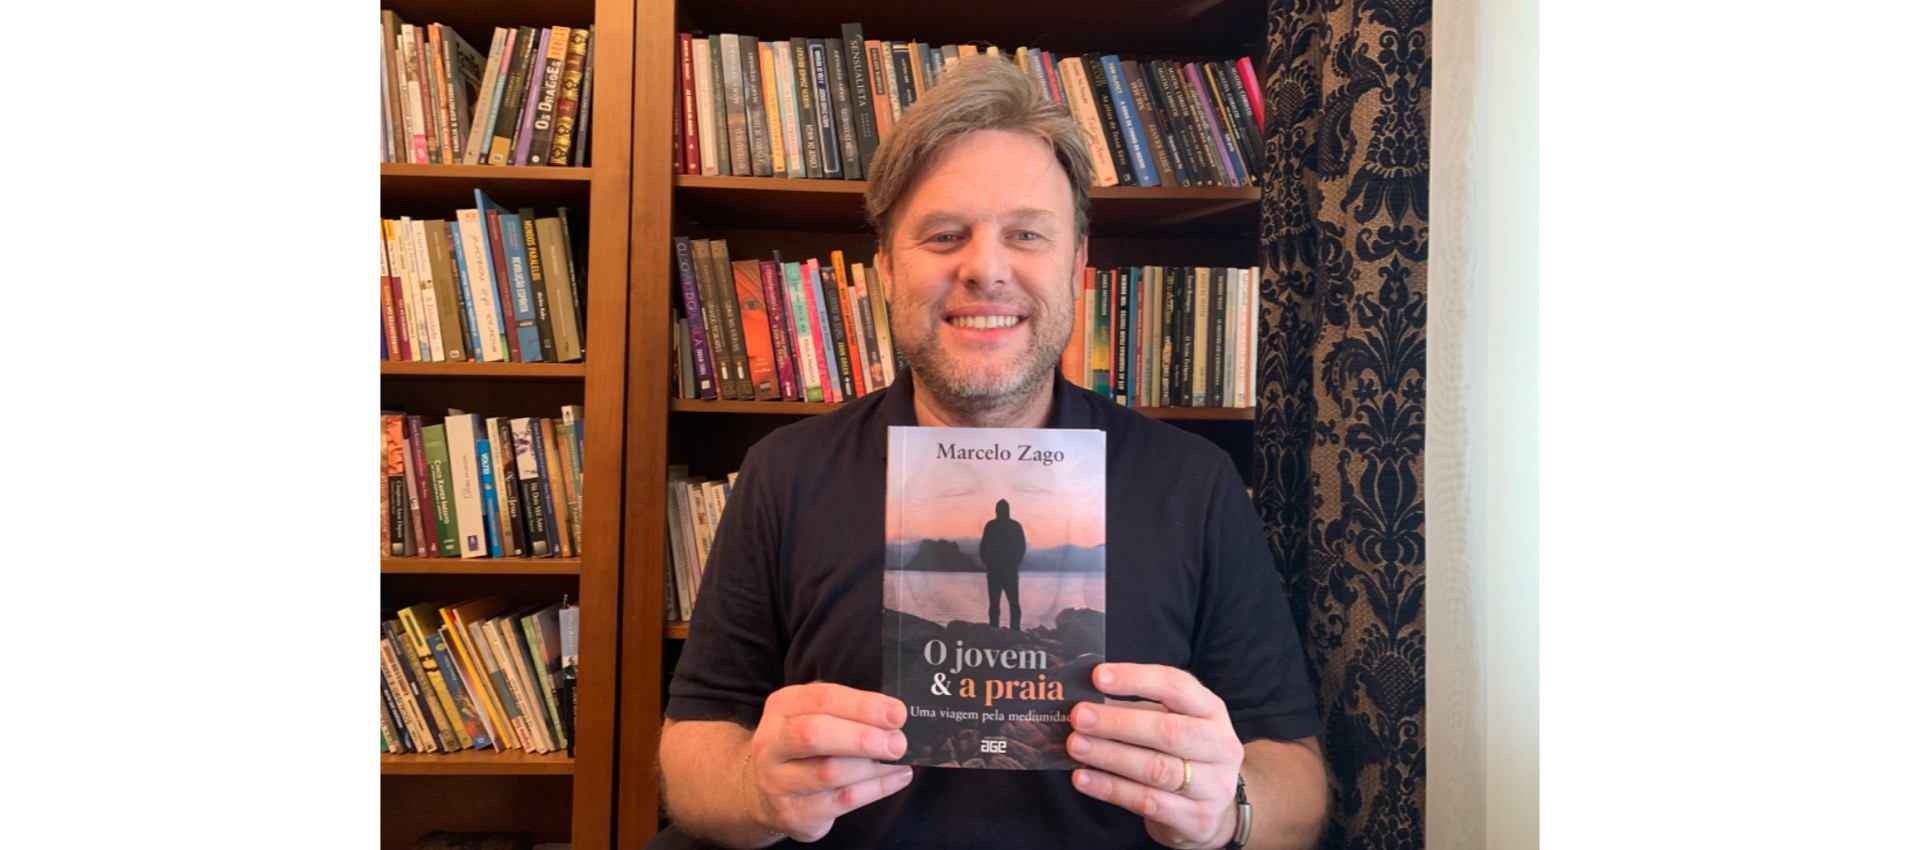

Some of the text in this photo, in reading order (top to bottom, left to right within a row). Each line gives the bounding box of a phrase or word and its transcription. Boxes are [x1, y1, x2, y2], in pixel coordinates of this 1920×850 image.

[729, 44, 738, 79] STEWART
[796, 47, 810, 108] MARION ZIMMER BRADLEY
[834, 50, 843, 80] STEWART
[850, 40, 866, 107] SENSUALISTA
[1108, 62, 1123, 94] TOM CLANCY
[447, 83, 458, 121] ESPIRITISMO
[751, 84, 759, 103] MARY
[1131, 82, 1145, 111] NAS ASAS
[1158, 67, 1169, 89] AGATHA
[1166, 91, 1179, 117] CHRISTIE
[1168, 67, 1189, 116] AGATHA CHRISTIE
[1219, 70, 1240, 118] AGATHA CHRISTIE
[1231, 67, 1252, 116] AGATHA CHRISTIE
[807, 141, 815, 149] DA
[1102, 95, 1109, 103] As
[1110, 121, 1117, 130] de
[1117, 150, 1126, 165] Kent
[1148, 124, 1163, 149] KRANTZ
[1135, 151, 1146, 169] MEDOS
[1158, 150, 1172, 173] JUDITH
[523, 220, 541, 281] MUNDOS PARALELOS
[384, 285, 392, 306] MENTE
[480, 288, 490, 306] de
[511, 256, 529, 313] REVOLUÇÃO ESPÍRITA
[389, 316, 398, 354] HORIZONTES
[486, 314, 498, 352] maria
[802, 338, 815, 383] PAULA PIMENTA
[837, 342, 849, 375] JOHN GREEN
[936, 442, 1064, 466] Marcelo Zago
[434, 460, 450, 524] CHICO XAVIER INÉDITO
[530, 482, 538, 491] Há
[532, 492, 540, 505] Dois
[534, 506, 542, 516] Mil
[924, 640, 1047, 674] O jovem
[930, 672, 1064, 706] & a praia
[910, 706, 936, 718] Uma
[940, 708, 978, 720] viagem
[982, 710, 1005, 722] pela
